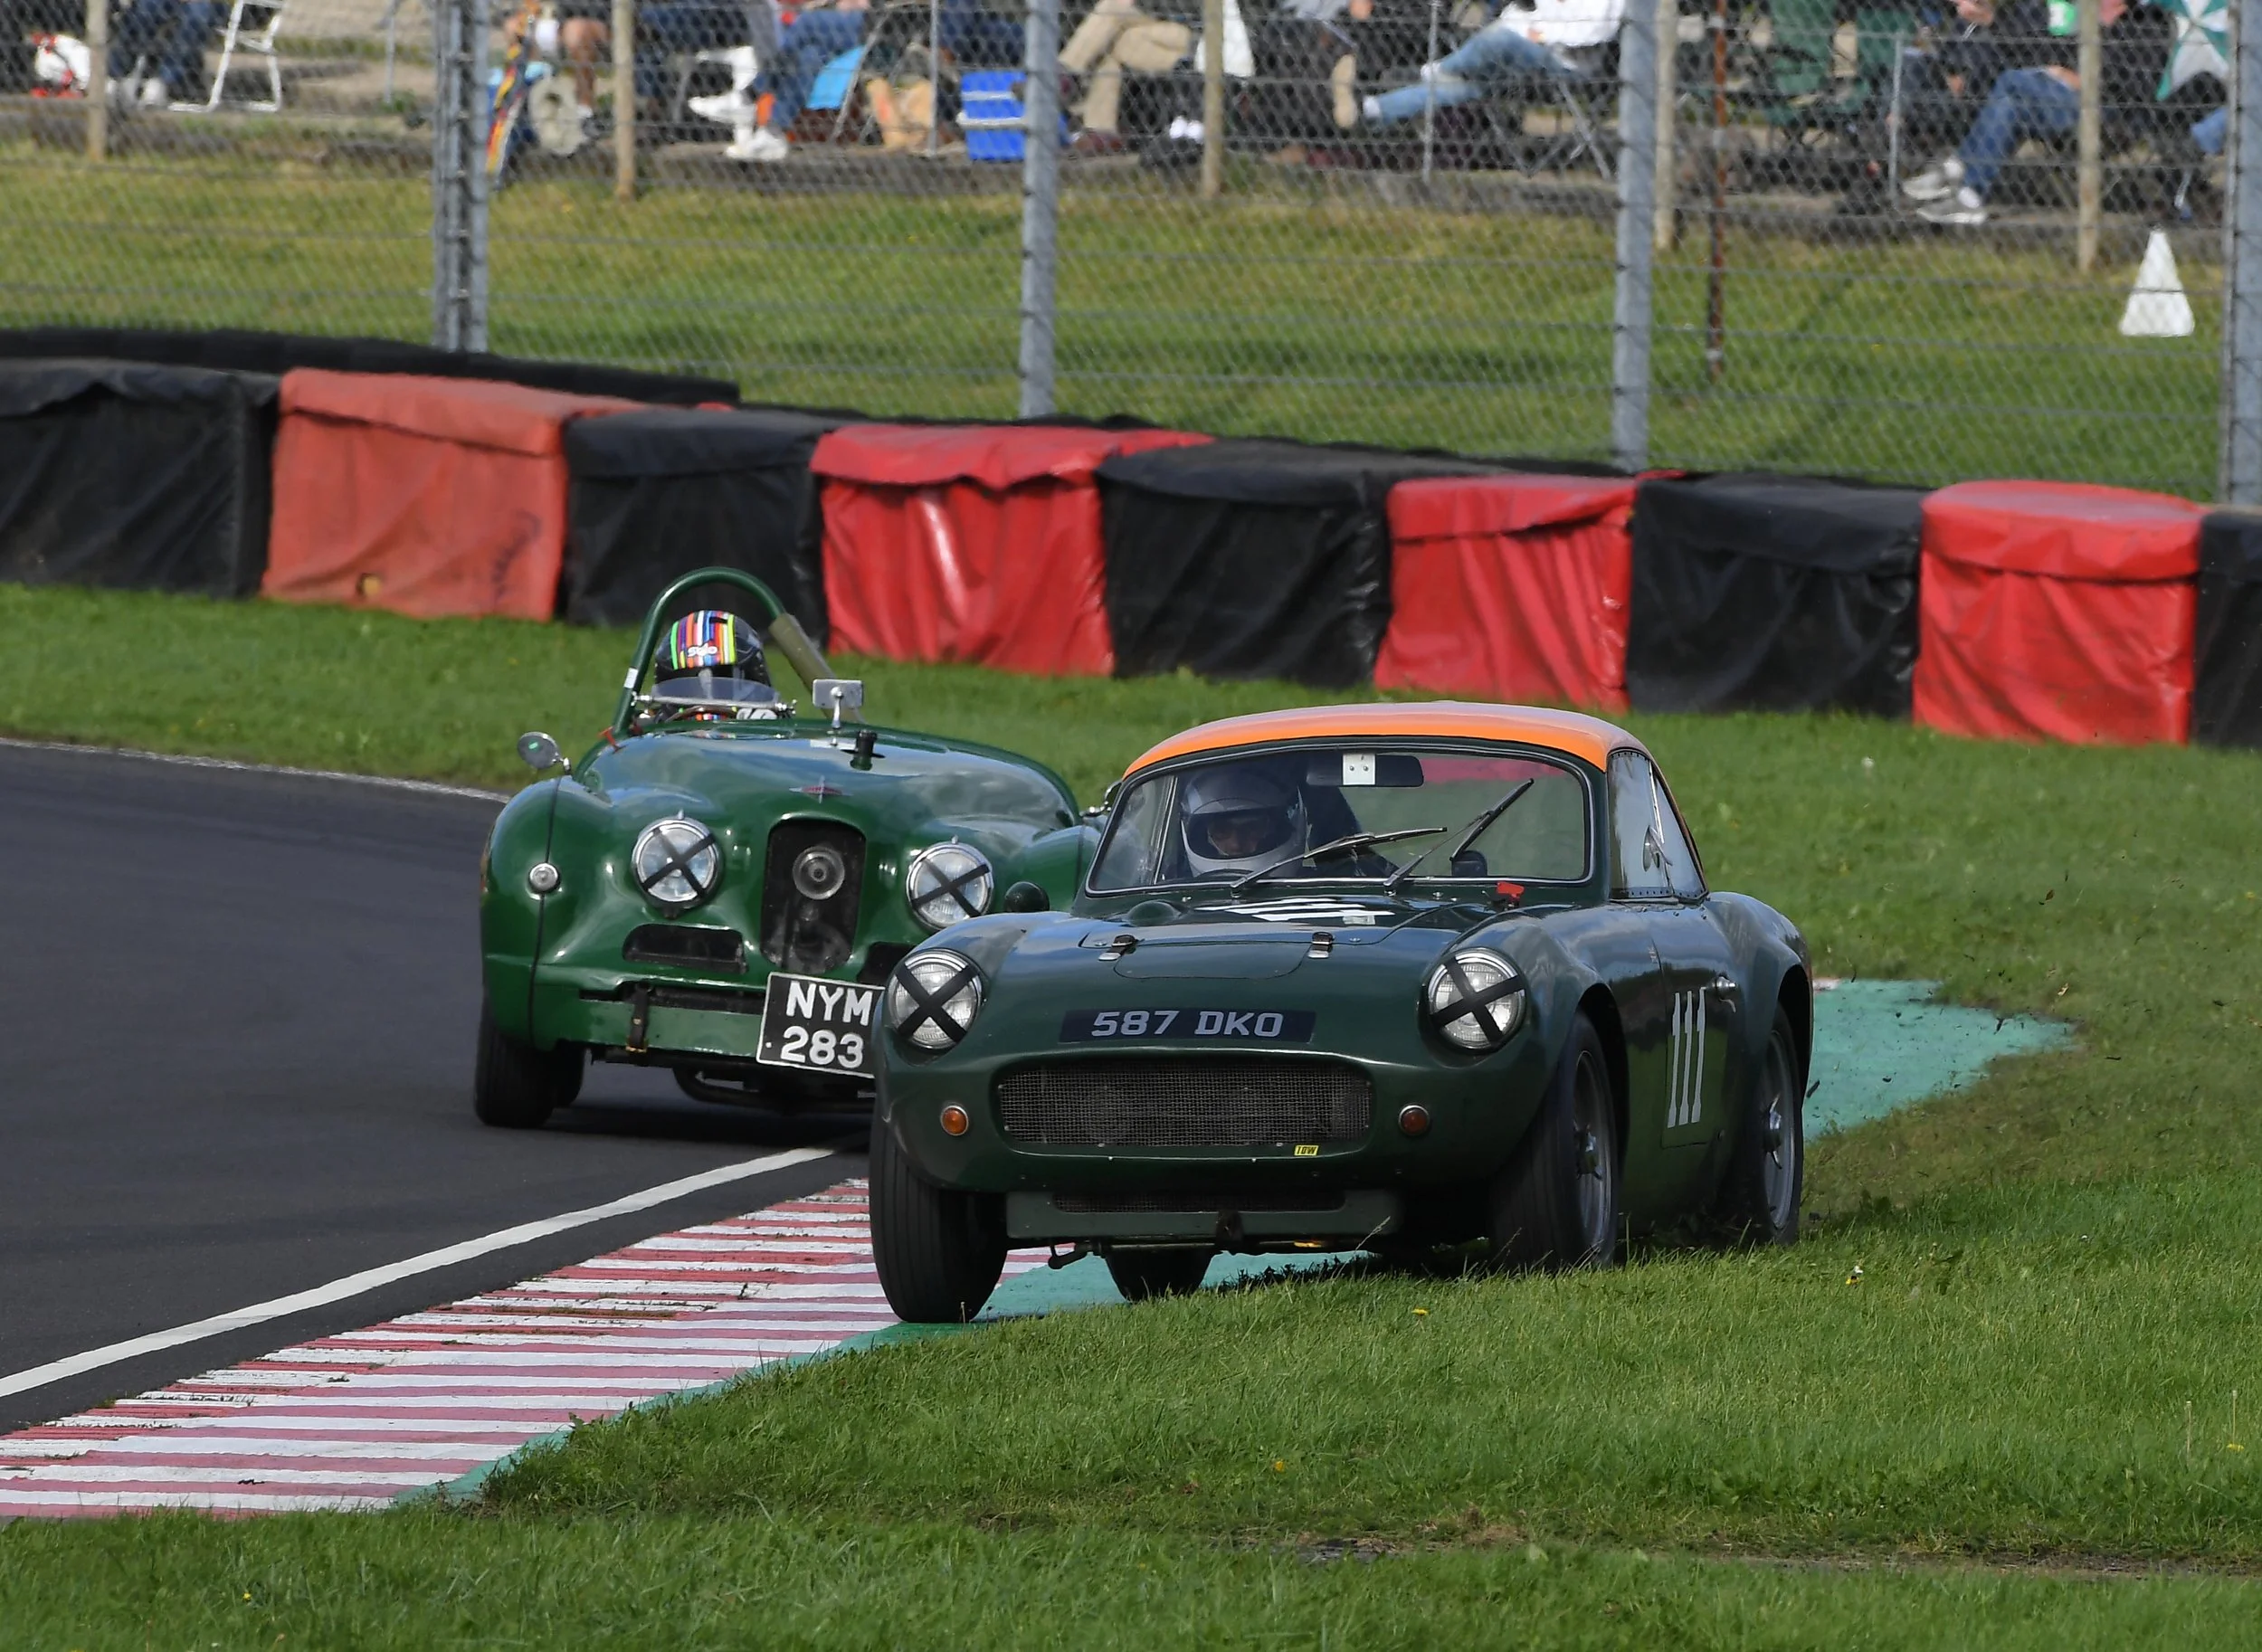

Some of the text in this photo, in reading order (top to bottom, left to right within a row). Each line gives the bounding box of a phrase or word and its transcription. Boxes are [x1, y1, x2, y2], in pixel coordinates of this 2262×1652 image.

[785, 980, 873, 1027] NYM
[1091, 1010, 1283, 1037] 587 DKO
[780, 1025, 864, 1068] 283
